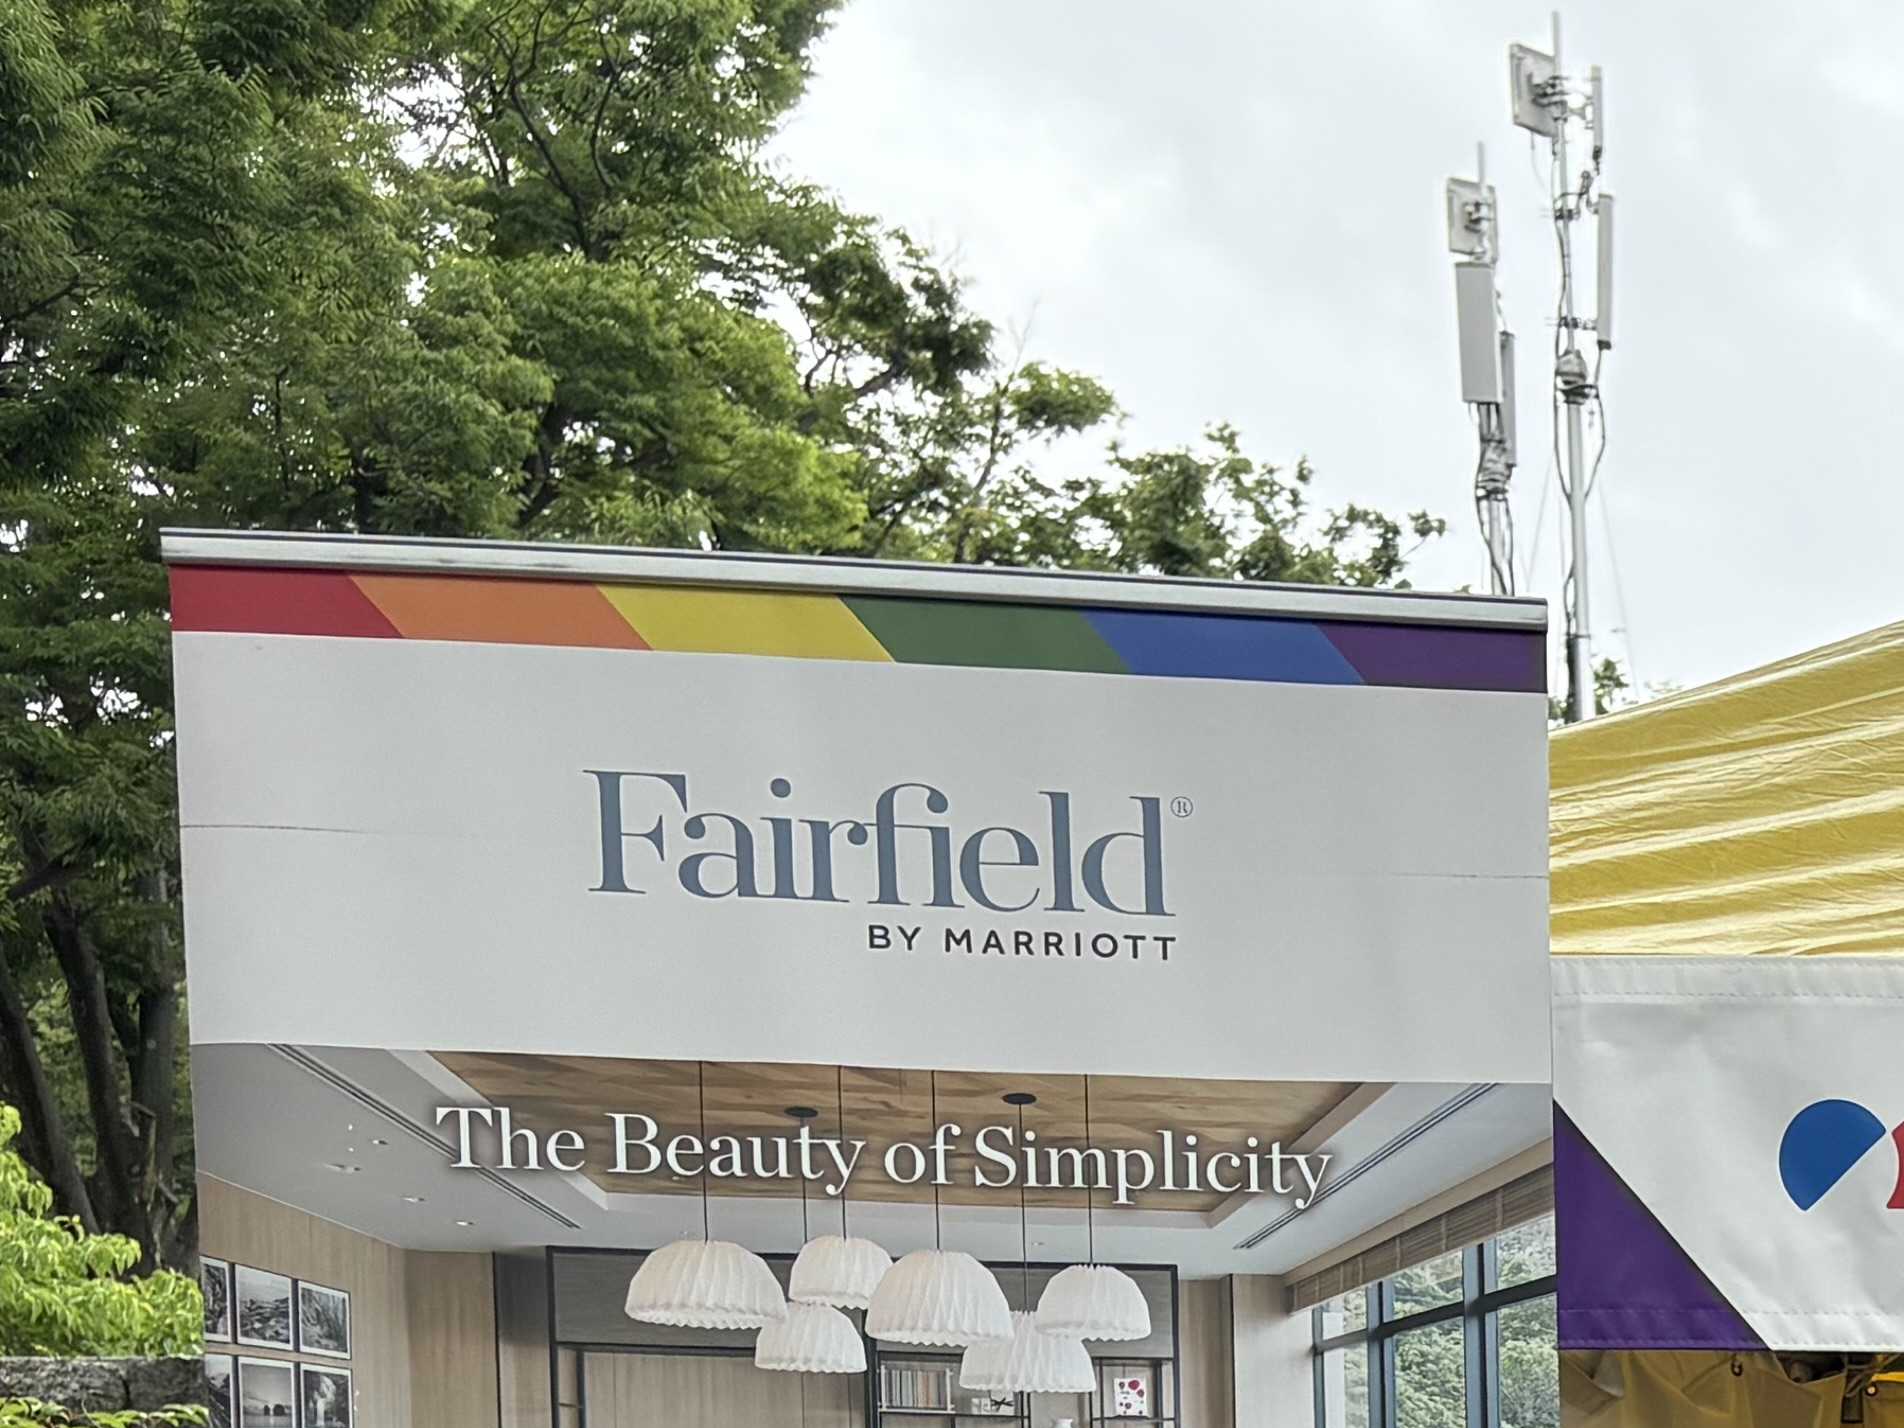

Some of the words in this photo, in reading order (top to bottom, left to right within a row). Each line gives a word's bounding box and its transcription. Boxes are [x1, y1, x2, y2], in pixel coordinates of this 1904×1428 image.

[867, 922, 923, 954] BY
[944, 926, 1178, 961] MARRIOTT
[435, 1104, 584, 1173] The
[606, 1112, 865, 1196] Beauty
[885, 1121, 960, 1187] of
[973, 1124, 1332, 1209] Simplicity
